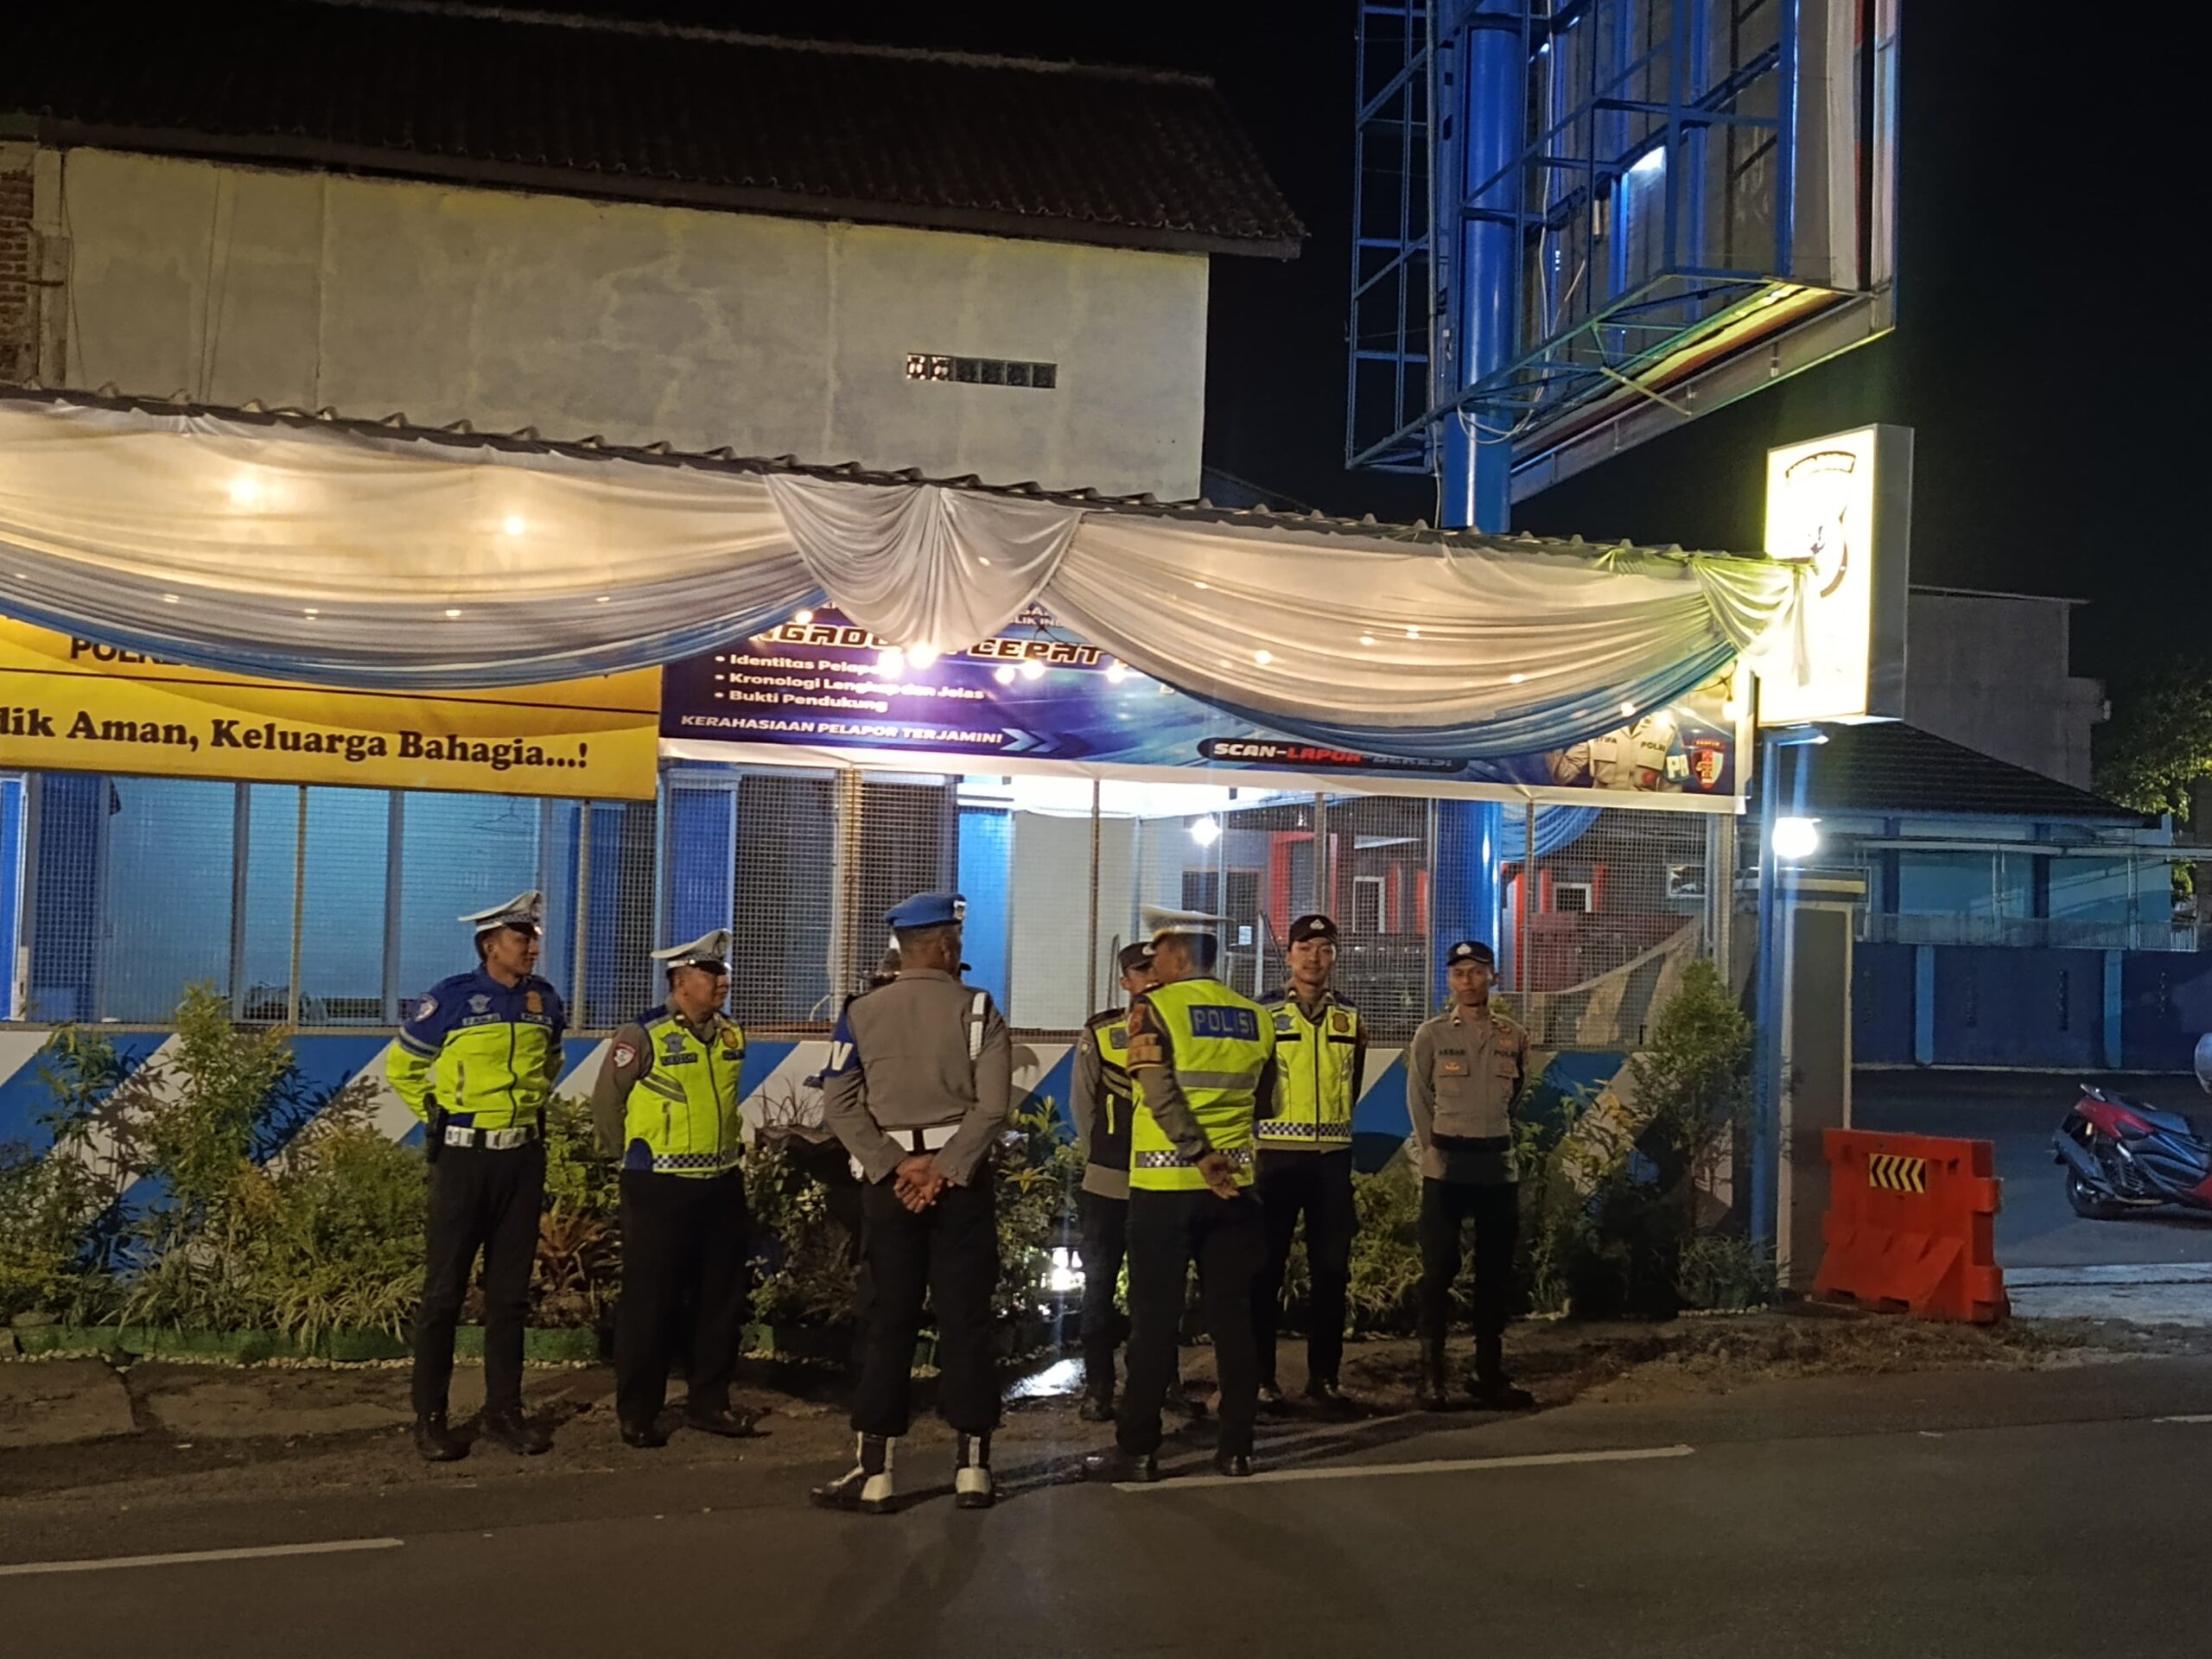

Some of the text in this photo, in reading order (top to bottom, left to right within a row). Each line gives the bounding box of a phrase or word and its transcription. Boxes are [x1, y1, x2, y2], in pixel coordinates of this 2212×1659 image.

[730, 654, 814, 670] Identitas
[968, 637, 1104, 665] CEPAT
[730, 672, 820, 690] Kronologi
[729, 690, 889, 713] Bukti Pendukung
[67, 710, 199, 752] Aman,
[212, 719, 388, 762] Keluarga
[398, 731, 588, 771] Bahagia...!
[681, 715, 1003, 744] KERAHASIAAN PELAPOR TERJAMIN!
[1192, 1008, 1255, 1036] POLISI
